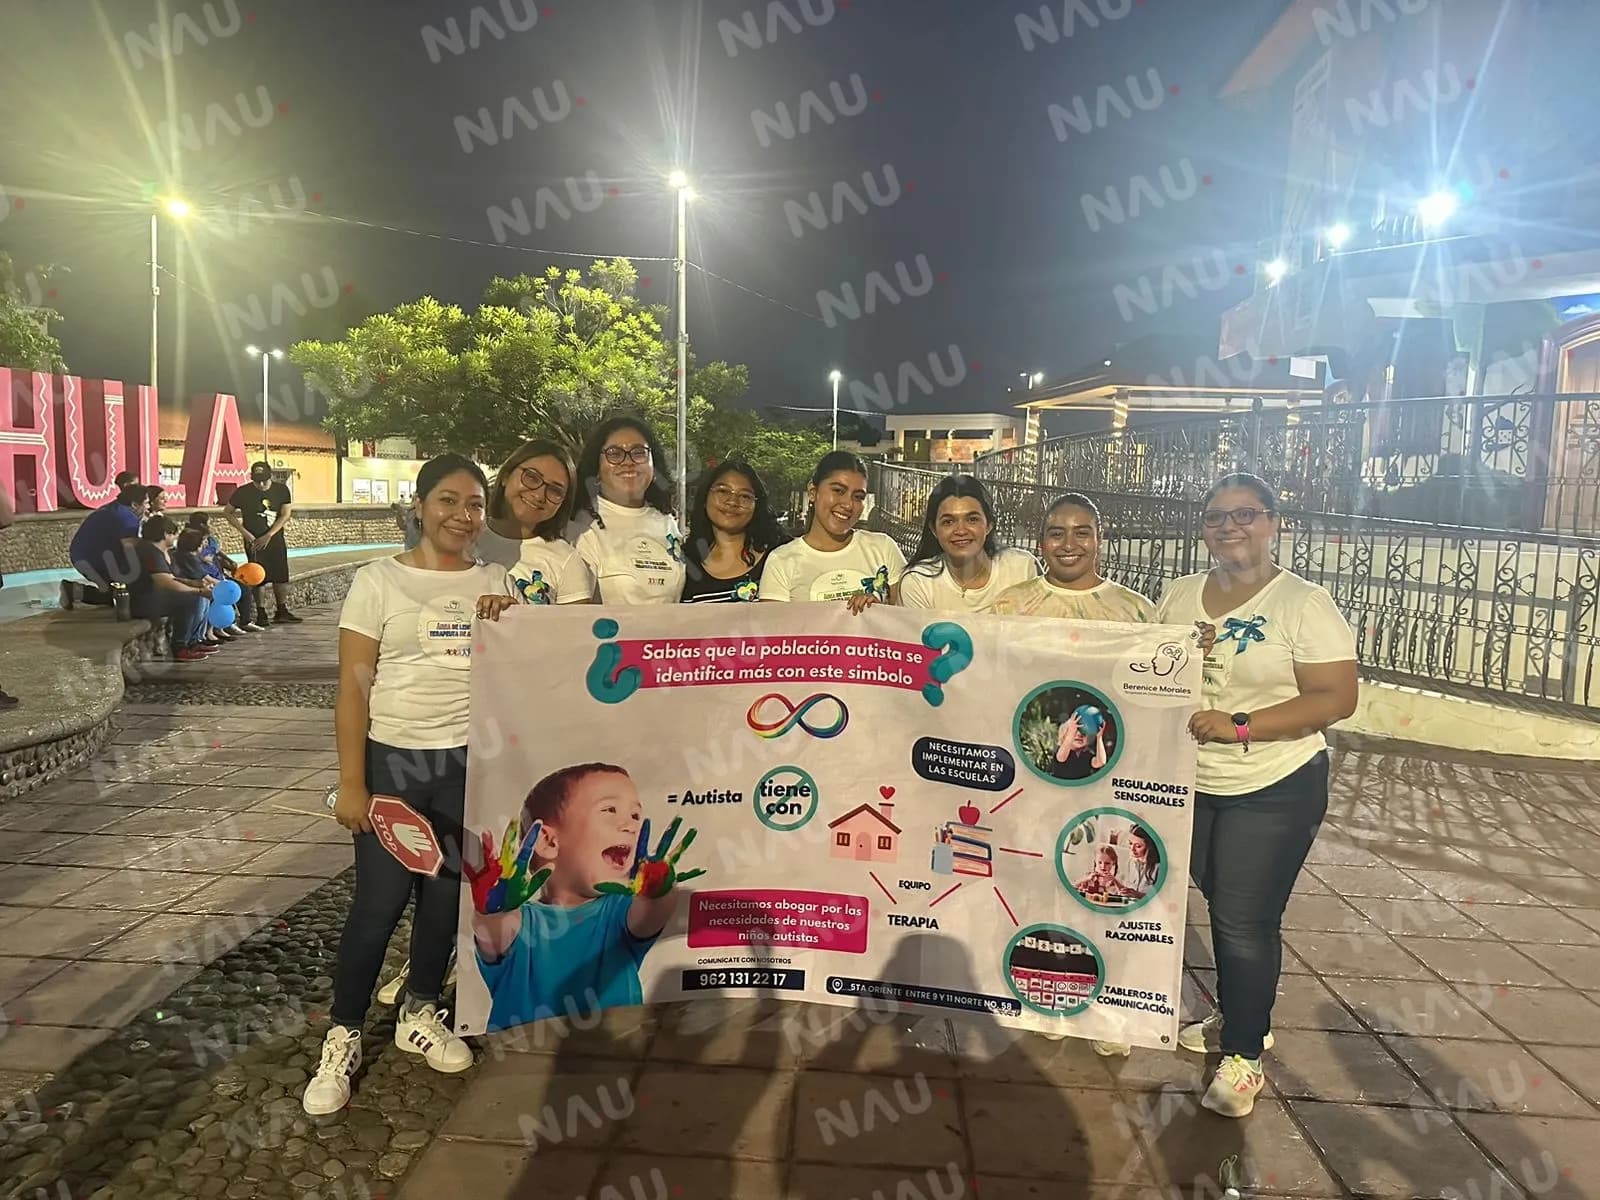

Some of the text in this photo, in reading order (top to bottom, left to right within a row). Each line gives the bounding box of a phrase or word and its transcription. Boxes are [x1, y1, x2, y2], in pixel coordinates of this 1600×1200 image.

[642, 640, 923, 664] Sabías que la población autista se
[656, 664, 913, 685] identifica más con este simbolo
[1123, 682, 1158, 692] Berenice
[1159, 685, 1192, 695] Morales
[929, 742, 997, 759] NECESITAMOS
[922, 752, 1004, 773] IMPLEMENTAR EN
[928, 765, 996, 784] LAS ESCUELAS
[760, 780, 811, 798] tiene
[1111, 778, 1189, 795] REGULADORES
[681, 789, 743, 806] Autista
[1114, 791, 1185, 807] SENSORIALES
[766, 802, 802, 815] con
[374, 813, 398, 852] STOP
[898, 880, 931, 890] EQUIPO
[699, 898, 862, 916] Necesitamos abogar por las
[709, 914, 850, 931] necesidades de nuestros
[887, 914, 939, 930] TERAPIA
[1118, 920, 1162, 931] AJUSTES
[738, 930, 819, 943] niños autistas
[1105, 930, 1174, 944] RAZONABLES
[757, 957, 792, 965] NOSOTROS
[700, 972, 787, 986] 962 131 22 17
[868, 985, 903, 996] ORIENTE
[905, 989, 931, 1000] ENTRE
[932, 992, 938, 1001] 9
[954, 996, 982, 1007] NORTE
[1104, 985, 1168, 1003] TABLEROS DE
[1096, 995, 1174, 1016] COMUNICACIÓN
